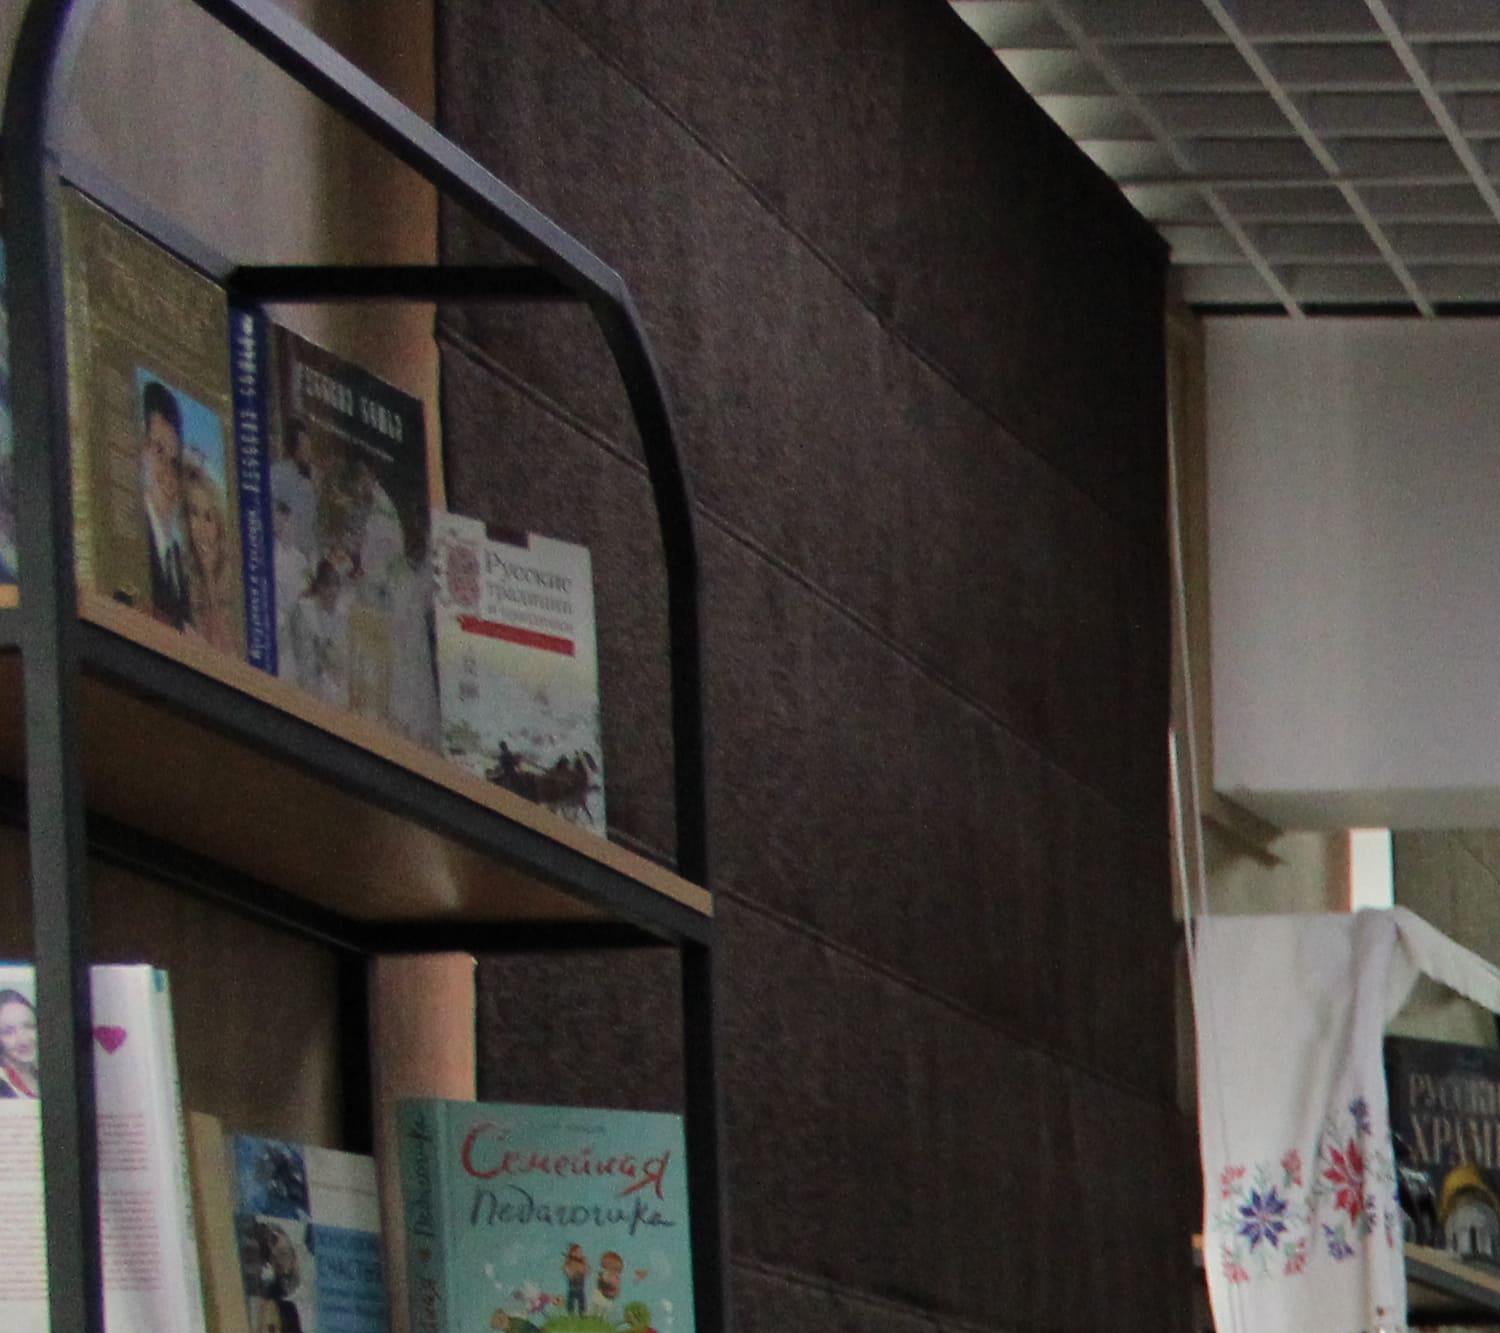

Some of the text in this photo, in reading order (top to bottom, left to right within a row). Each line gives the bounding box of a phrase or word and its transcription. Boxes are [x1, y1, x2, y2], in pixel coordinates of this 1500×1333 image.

[483, 548, 574, 594] Русские
[460, 1121, 671, 1201] Семейная
[470, 1184, 676, 1236] Педагогика
